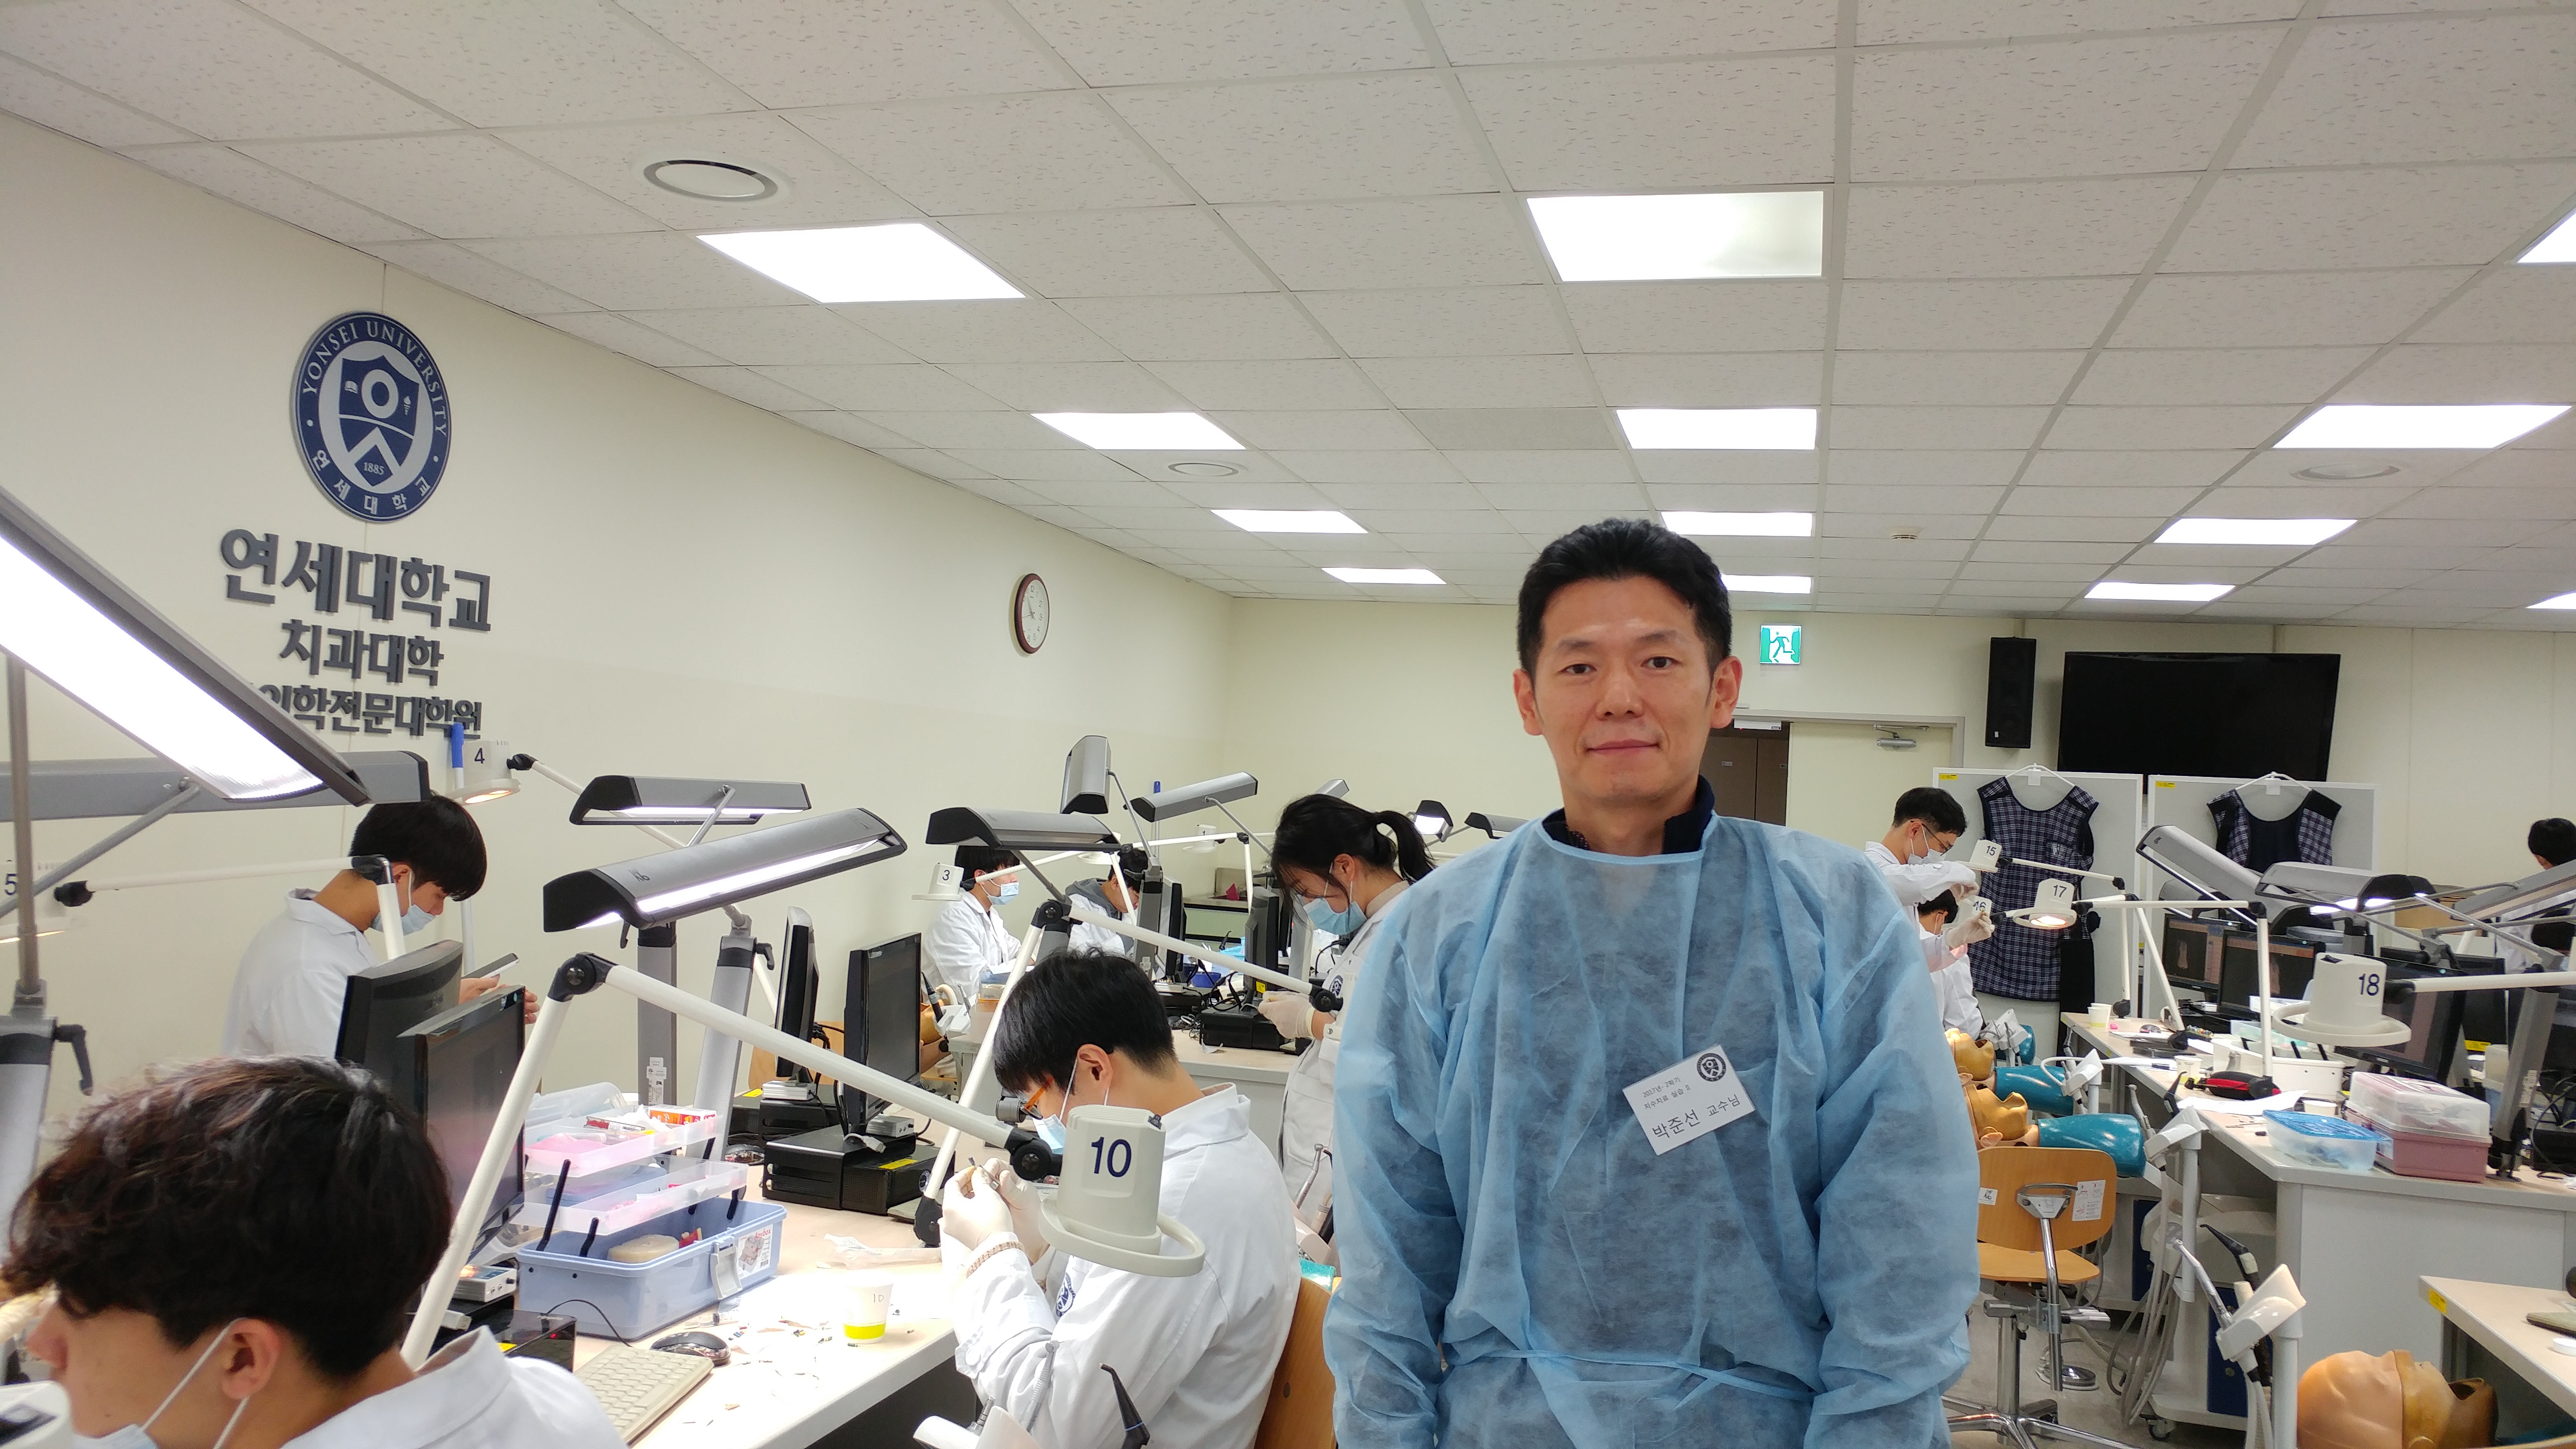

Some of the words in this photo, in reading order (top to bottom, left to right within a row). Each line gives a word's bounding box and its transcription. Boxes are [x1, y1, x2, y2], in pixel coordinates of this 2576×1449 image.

[303, 322, 359, 395] YONSEI
[366, 320, 447, 437] UNIVERSITY
[363, 461, 384, 476] 1885
[221, 529, 491, 631] 연세대학교
[280, 619, 444, 686] 치과대학
[474, 747, 485, 764] 4
[1986, 845, 1997, 856] 15
[4, 873, 18, 896] 5
[942, 869, 950, 881] 3
[2053, 885, 2067, 898] 17
[1975, 901, 1986, 912] 16
[2359, 973, 2379, 996] 18
[1652, 1109, 1701, 1139] 박준선
[1707, 1094, 1741, 1117] 교수님
[1091, 1136, 1132, 1177] 10
